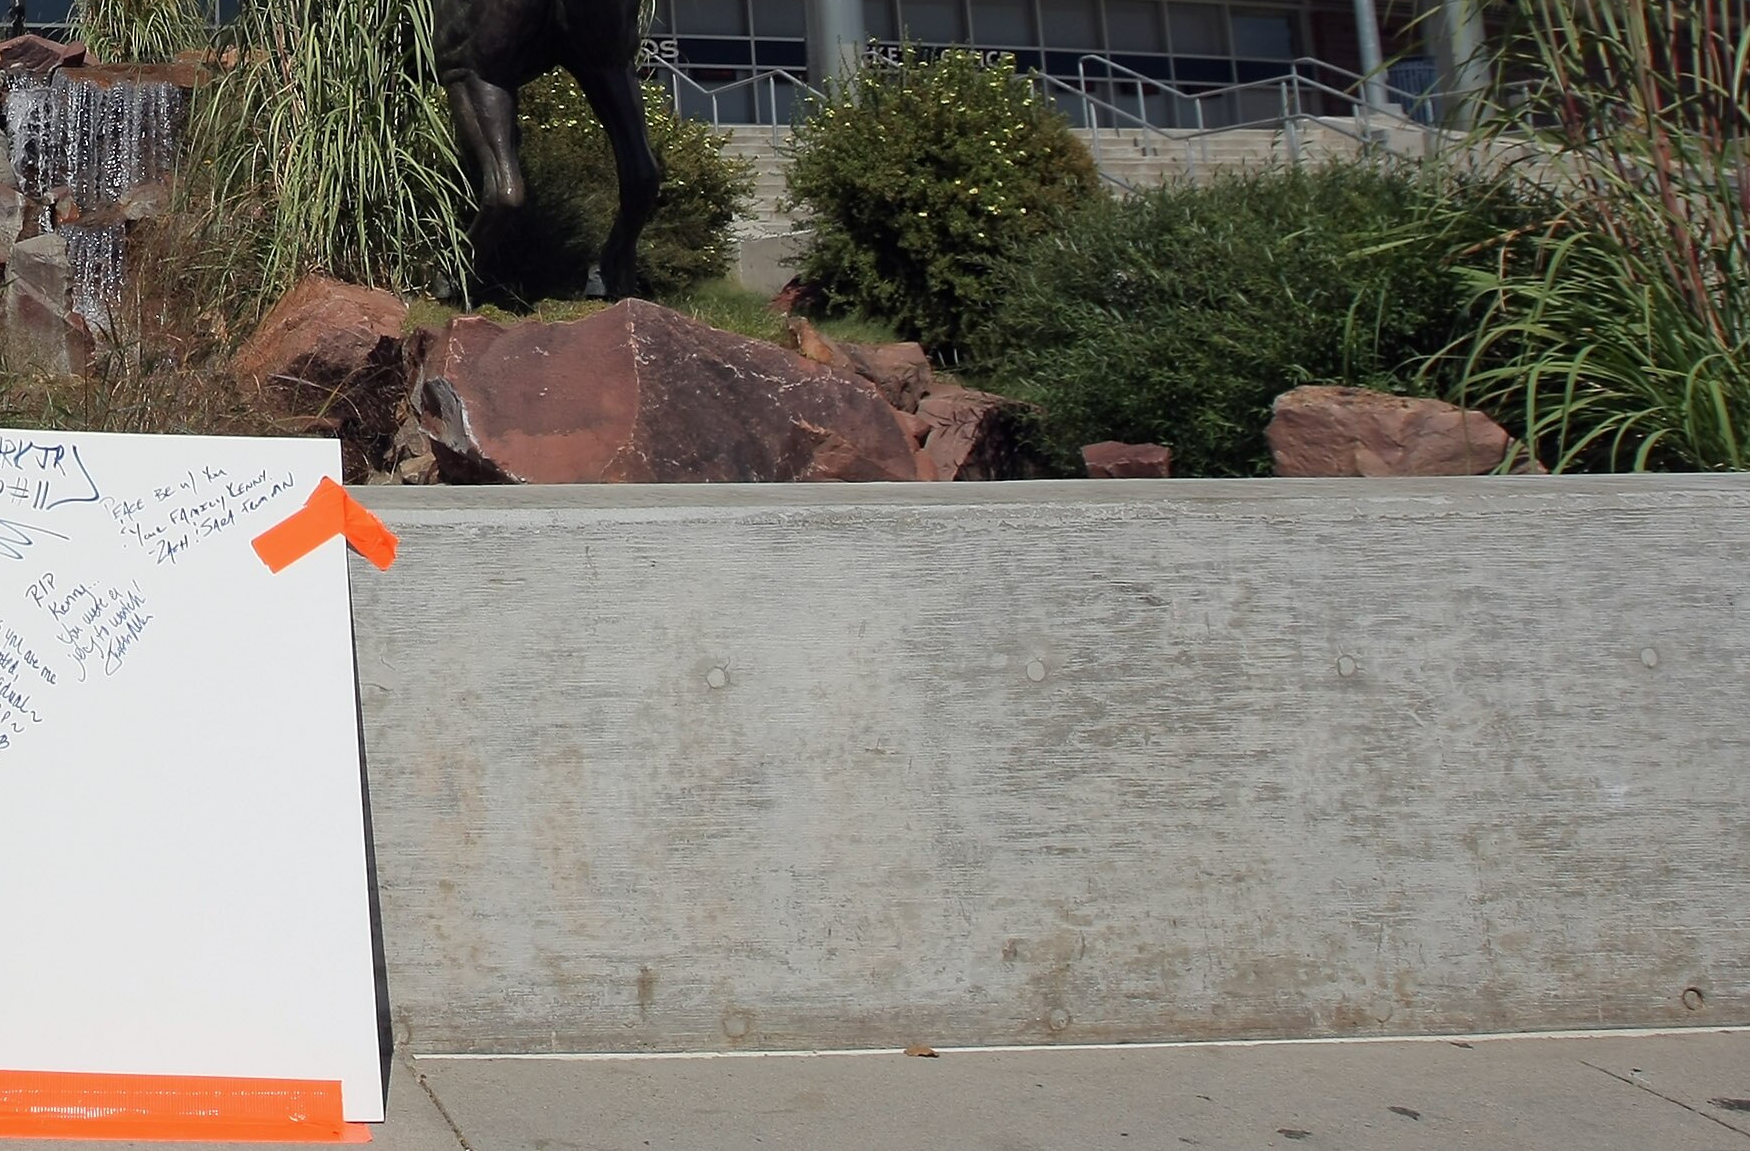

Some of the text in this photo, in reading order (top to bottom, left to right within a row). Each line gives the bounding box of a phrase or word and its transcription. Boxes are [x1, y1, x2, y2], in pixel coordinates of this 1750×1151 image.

[153, 484, 176, 502] BE
[25, 572, 55, 608] RIP
[82, 598, 108, 625] were
[108, 587, 123, 601] a
